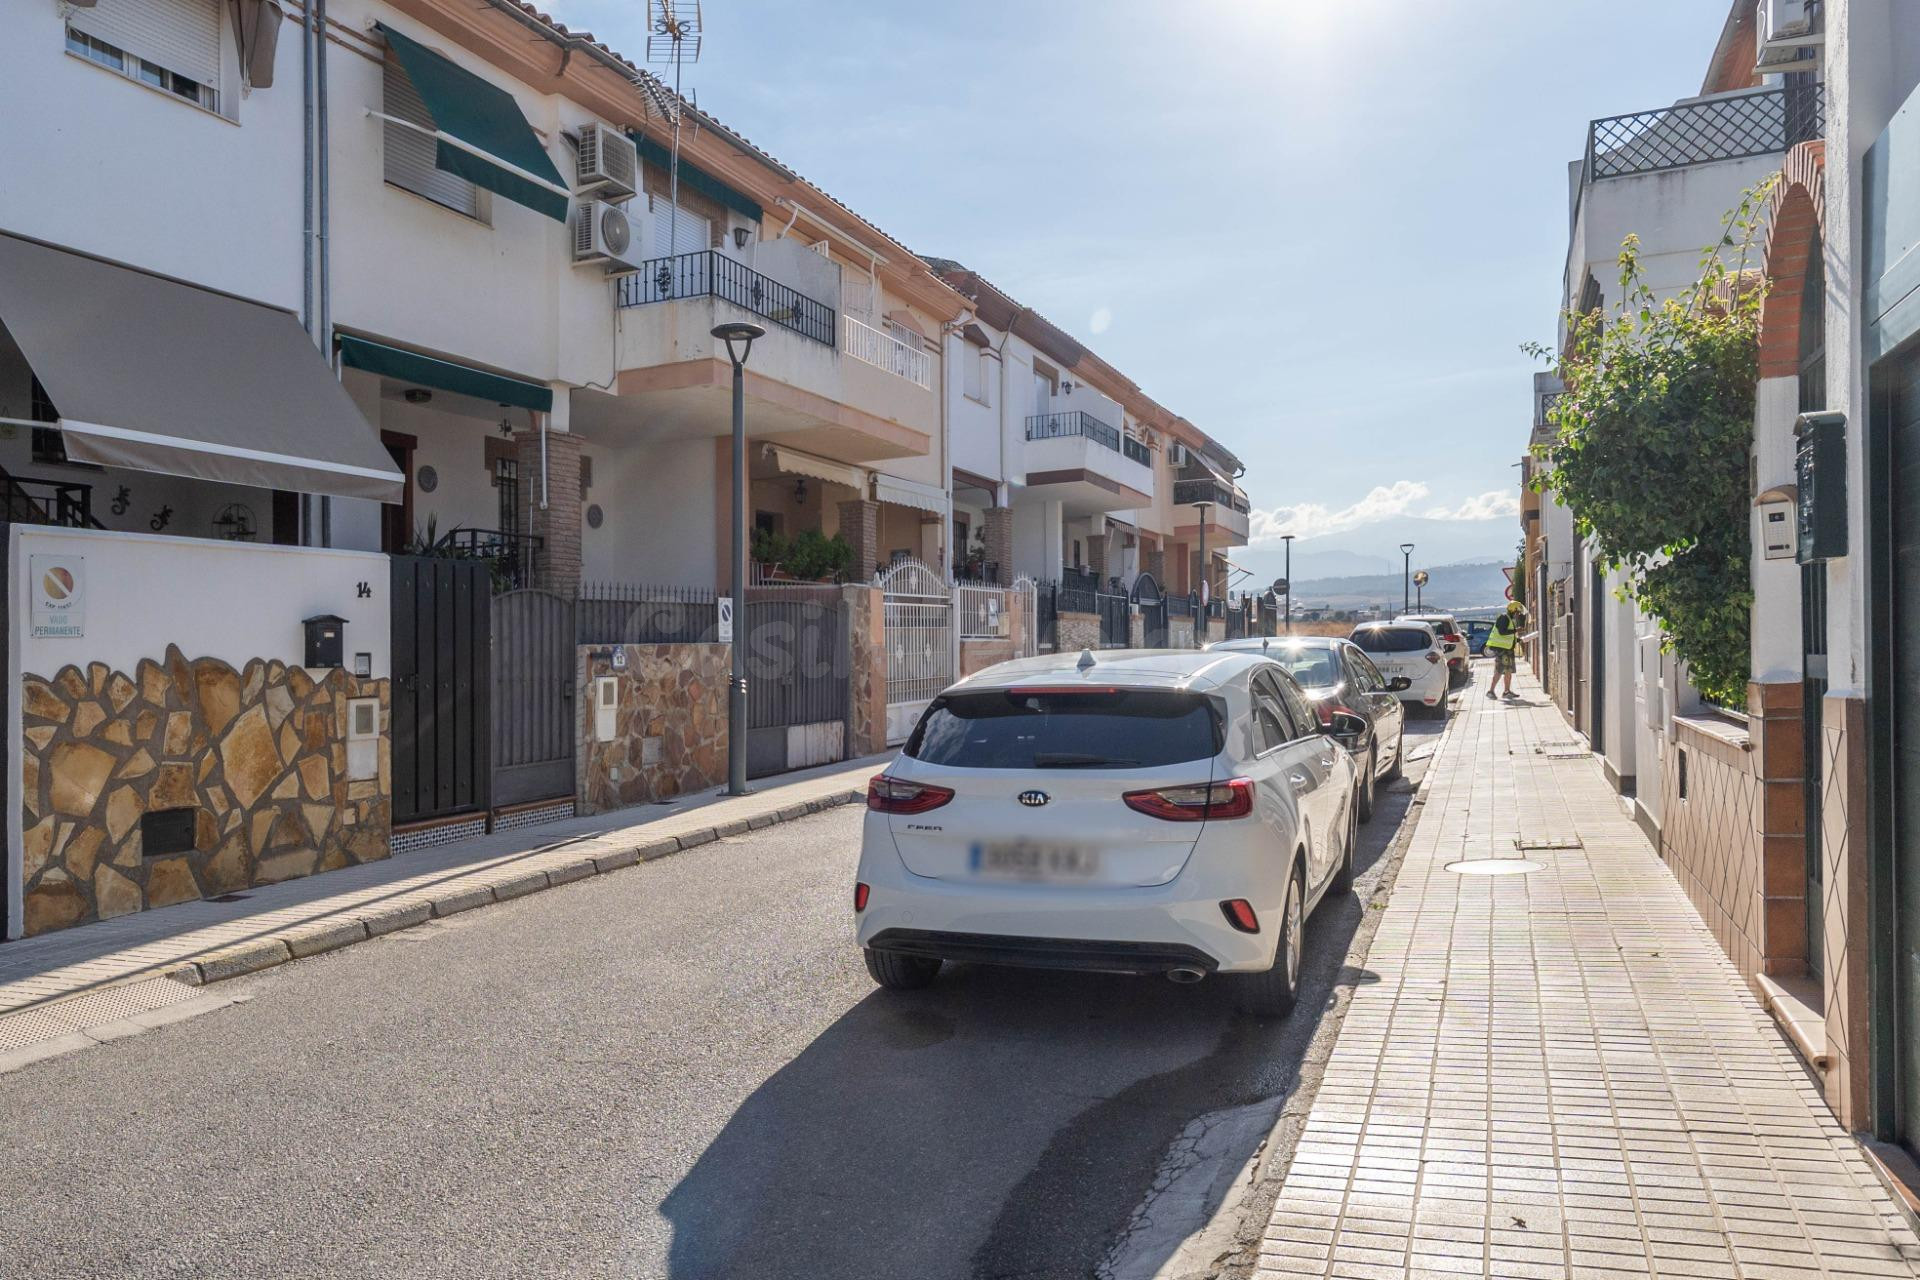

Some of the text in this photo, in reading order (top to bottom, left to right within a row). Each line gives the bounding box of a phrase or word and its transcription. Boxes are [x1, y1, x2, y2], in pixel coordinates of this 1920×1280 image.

[356, 581, 372, 598] 14
[35, 626, 81, 636] PERMANENTE
[1021, 792, 1045, 805] KIA
